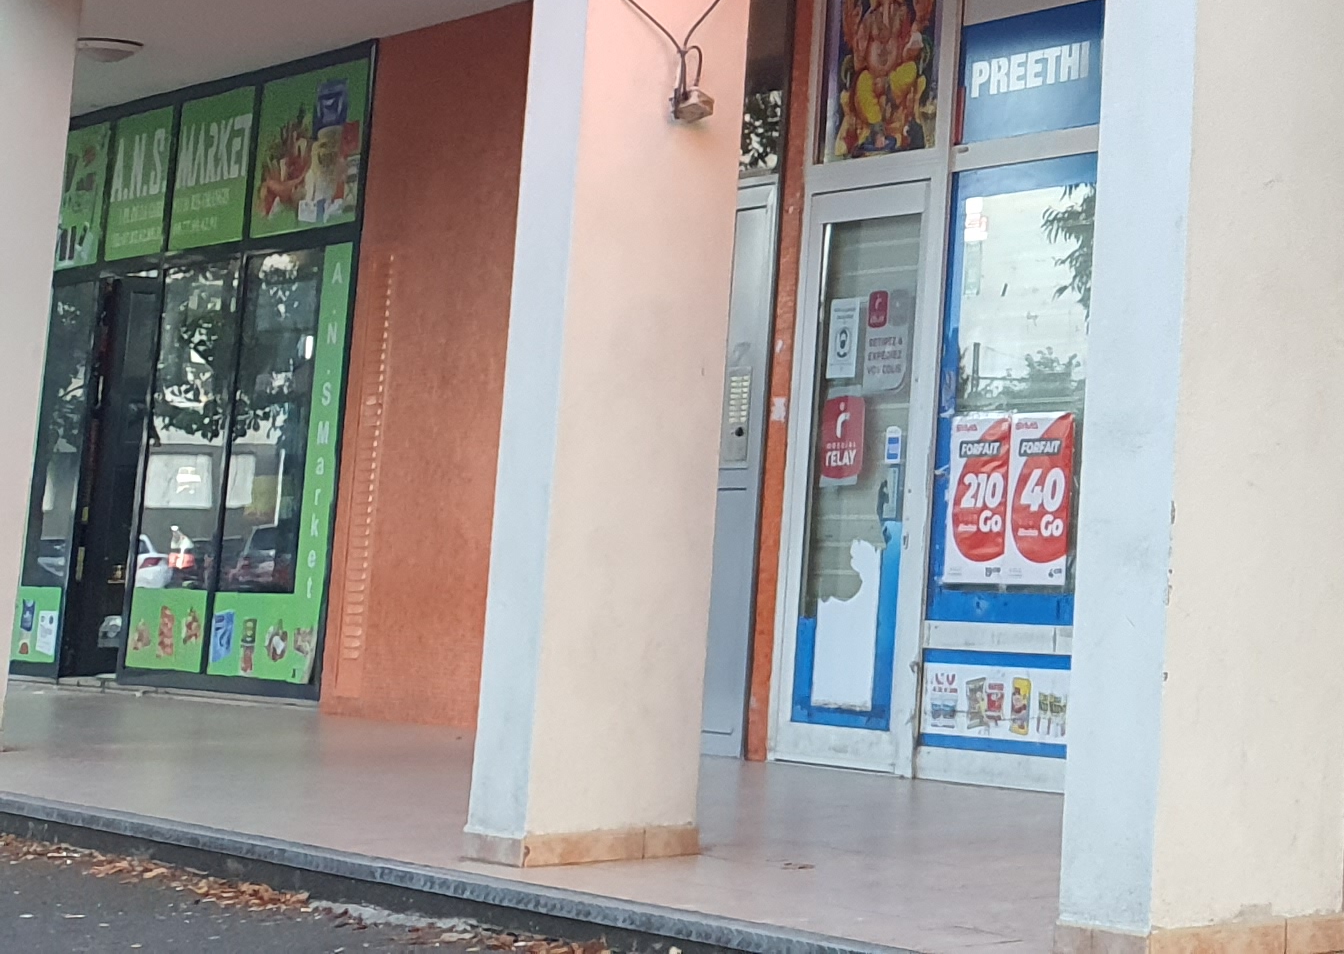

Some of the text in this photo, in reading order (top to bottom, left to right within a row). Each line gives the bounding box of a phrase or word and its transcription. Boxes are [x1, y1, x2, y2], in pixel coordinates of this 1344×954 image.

[970, 41, 1091, 98] PREETHI
[176, 113, 253, 189] MARKET
[961, 441, 1000, 455] FORFAIT
[1021, 440, 1060, 454] FORFAIT
[960, 472, 1004, 509] 210
[1020, 467, 1066, 512] 40
[979, 510, 1002, 532] Go
[1040, 514, 1063, 537] Go
